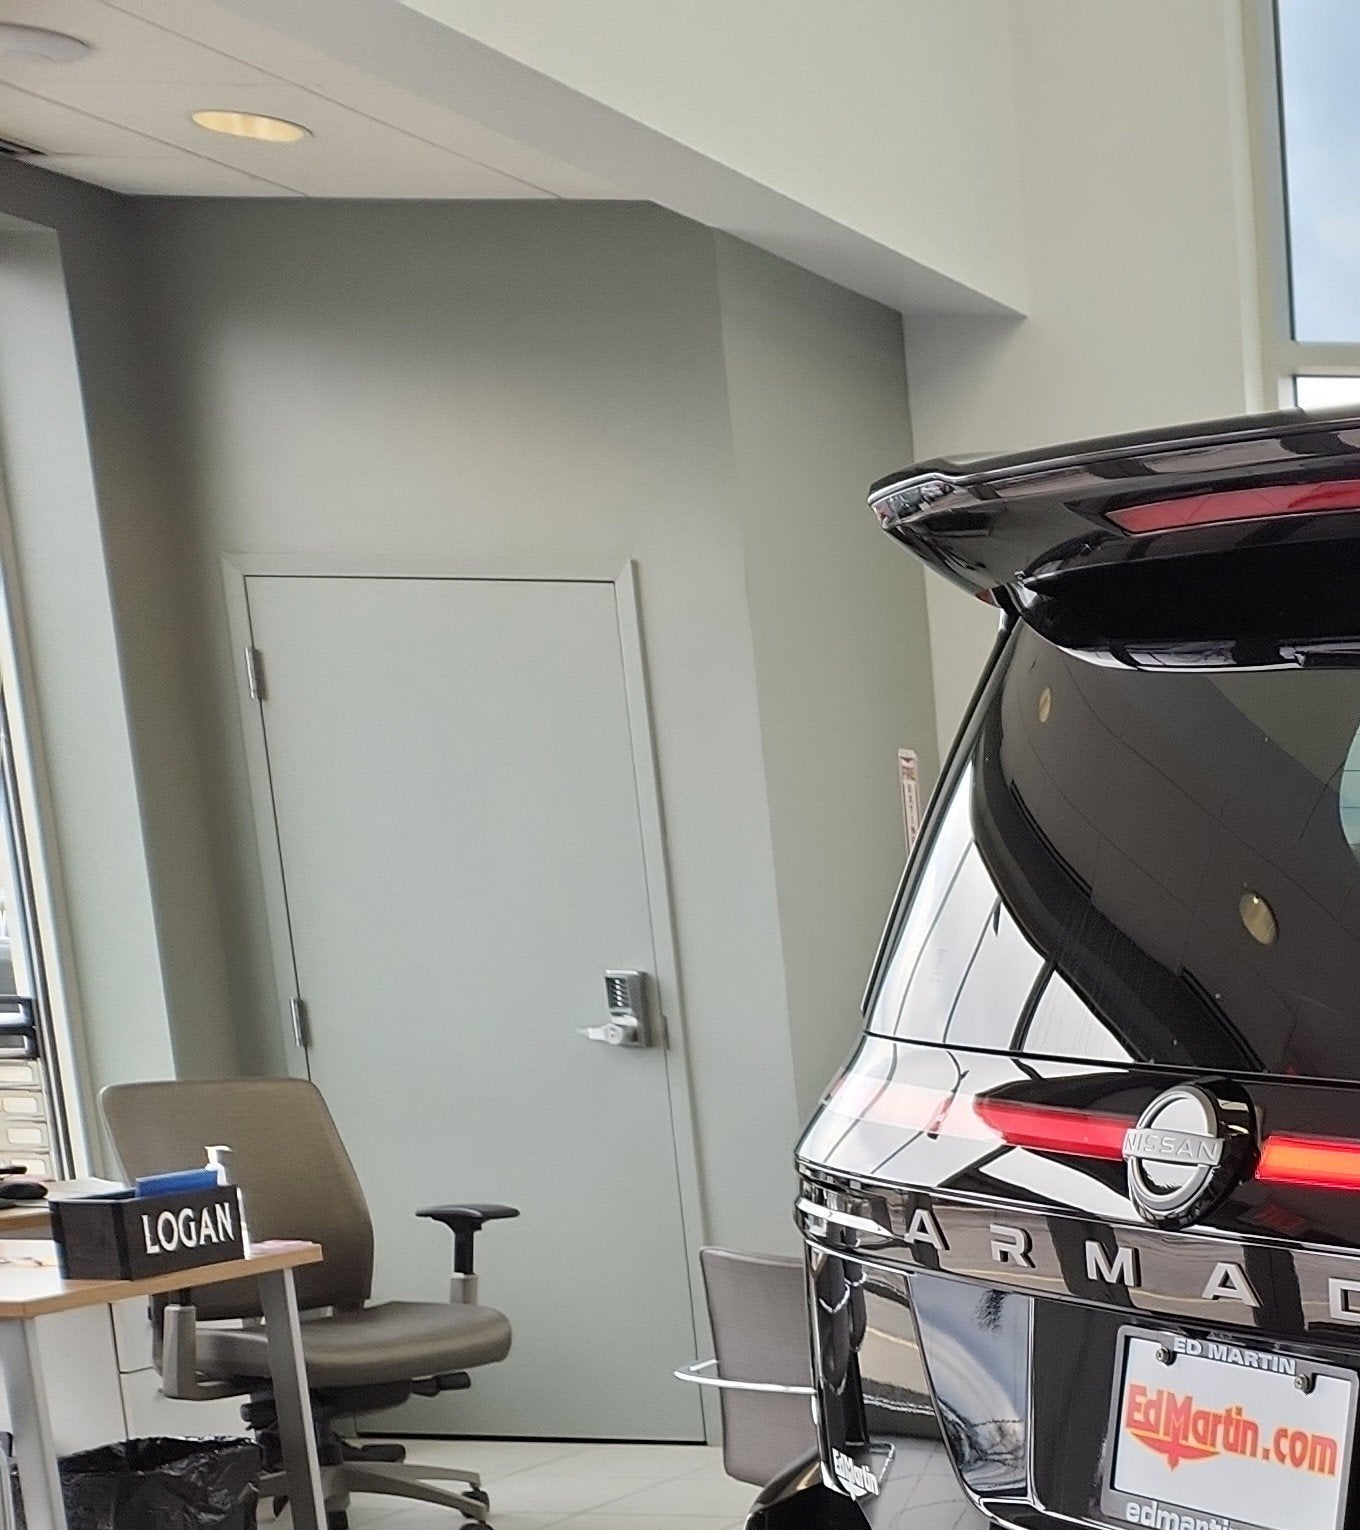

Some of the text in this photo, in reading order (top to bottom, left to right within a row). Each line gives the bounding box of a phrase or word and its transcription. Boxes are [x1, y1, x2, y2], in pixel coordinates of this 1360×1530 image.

[1124, 1132, 1219, 1159] NISSAN
[141, 1201, 236, 1255] LOGAN
[1173, 1338, 1297, 1376] ED MARTIN
[1125, 1383, 1338, 1477] EdMartin.com
